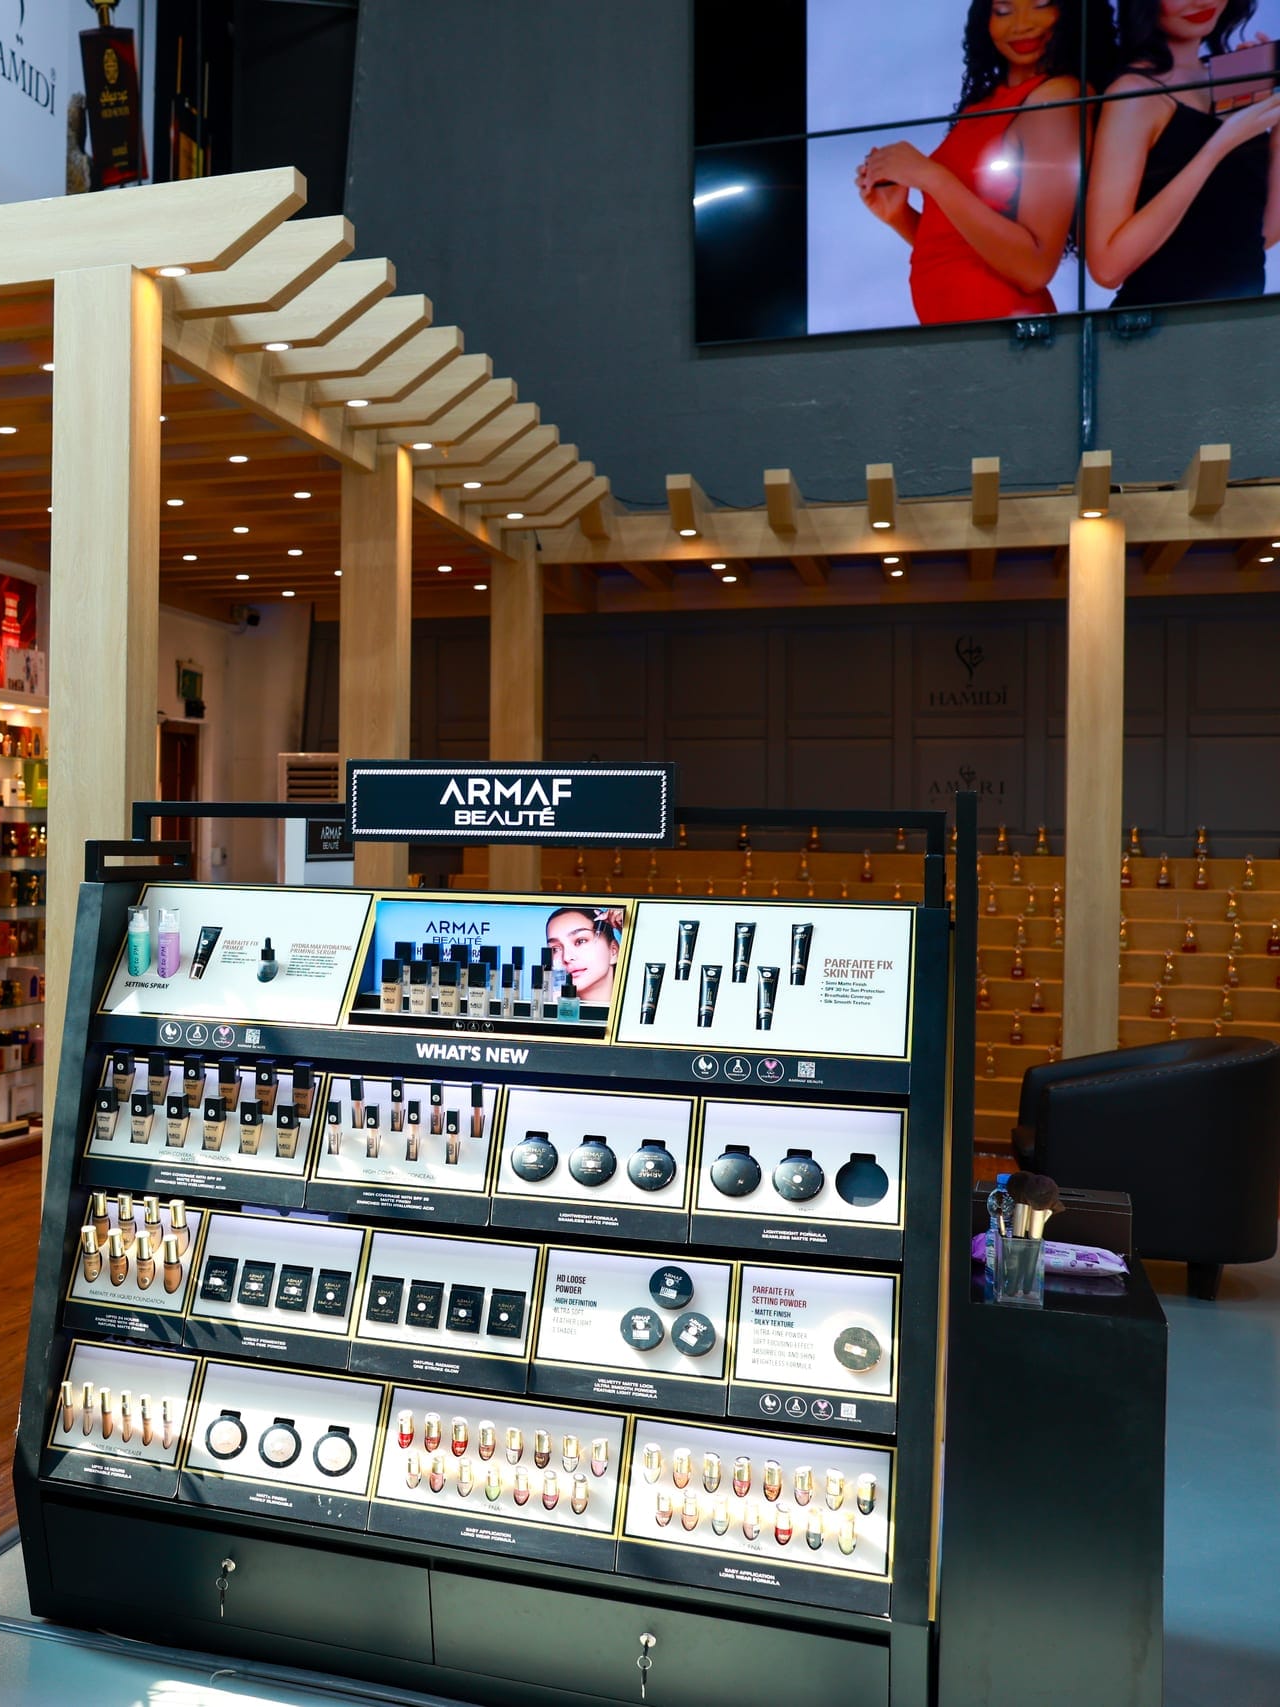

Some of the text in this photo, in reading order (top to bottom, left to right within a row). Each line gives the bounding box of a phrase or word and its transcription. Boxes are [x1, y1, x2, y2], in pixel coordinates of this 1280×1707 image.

[439, 777, 572, 806] ARMAF
[928, 780, 1005, 795] AMRI
[454, 807, 556, 827] BEAUTÉ
[320, 826, 343, 840] ARMAF
[322, 840, 340, 850] BEAUTÉ
[426, 920, 491, 935] ARMAF
[223, 939, 250, 947] PARFAITE
[432, 935, 482, 945] BEAUTÉ
[133, 945, 139, 956] PM
[160, 946, 166, 956] PM
[824, 958, 893, 970] PARFAITE FIX
[823, 968, 875, 979] SKIN TINT
[124, 981, 170, 990] SETTING SPRAY
[415, 1042, 529, 1065] WHAT'S NEW
[638, 1170, 663, 1178] ARMAF
[556, 1273, 587, 1285] HD LOOSE
[663, 1272, 683, 1281] ARMAF
[555, 1284, 582, 1295] POWDER
[752, 1285, 795, 1297] PARFAITE FIX
[89, 1289, 109, 1297] PARFAITE
[132, 1295, 165, 1305] FOUNDATION
[568, 1298, 598, 1308] DEFINITION
[751, 1296, 807, 1309] SETTING POWDER
[571, 1308, 585, 1316] SOFT
[754, 1308, 792, 1318] MATTE FINISH
[95, 1316, 117, 1324] ENRICHED
[576, 1319, 592, 1327] LIGHT
[630, 1314, 652, 1322] ARMAF
[97, 1321, 116, 1329] NATURAL
[754, 1318, 795, 1329] SILKY TEXTURE
[772, 1329, 808, 1339] FINE POWDER
[787, 1351, 816, 1361] AND SHINE
[435, 1362, 460, 1370] RADIANCE
[751, 1358, 812, 1371] WEIGHTLESS FORMULA
[631, 1392, 658, 1400] FORMULA
[110, 1471, 132, 1479] FORMULA
[460, 1530, 475, 1538] LONG
[490, 1535, 516, 1544] FORMULA
[479, 1529, 512, 1538] APPLICATION
[718, 1571, 781, 1586] LONG WEAR FORMULA
[739, 1570, 776, 1580] APPLICATION
